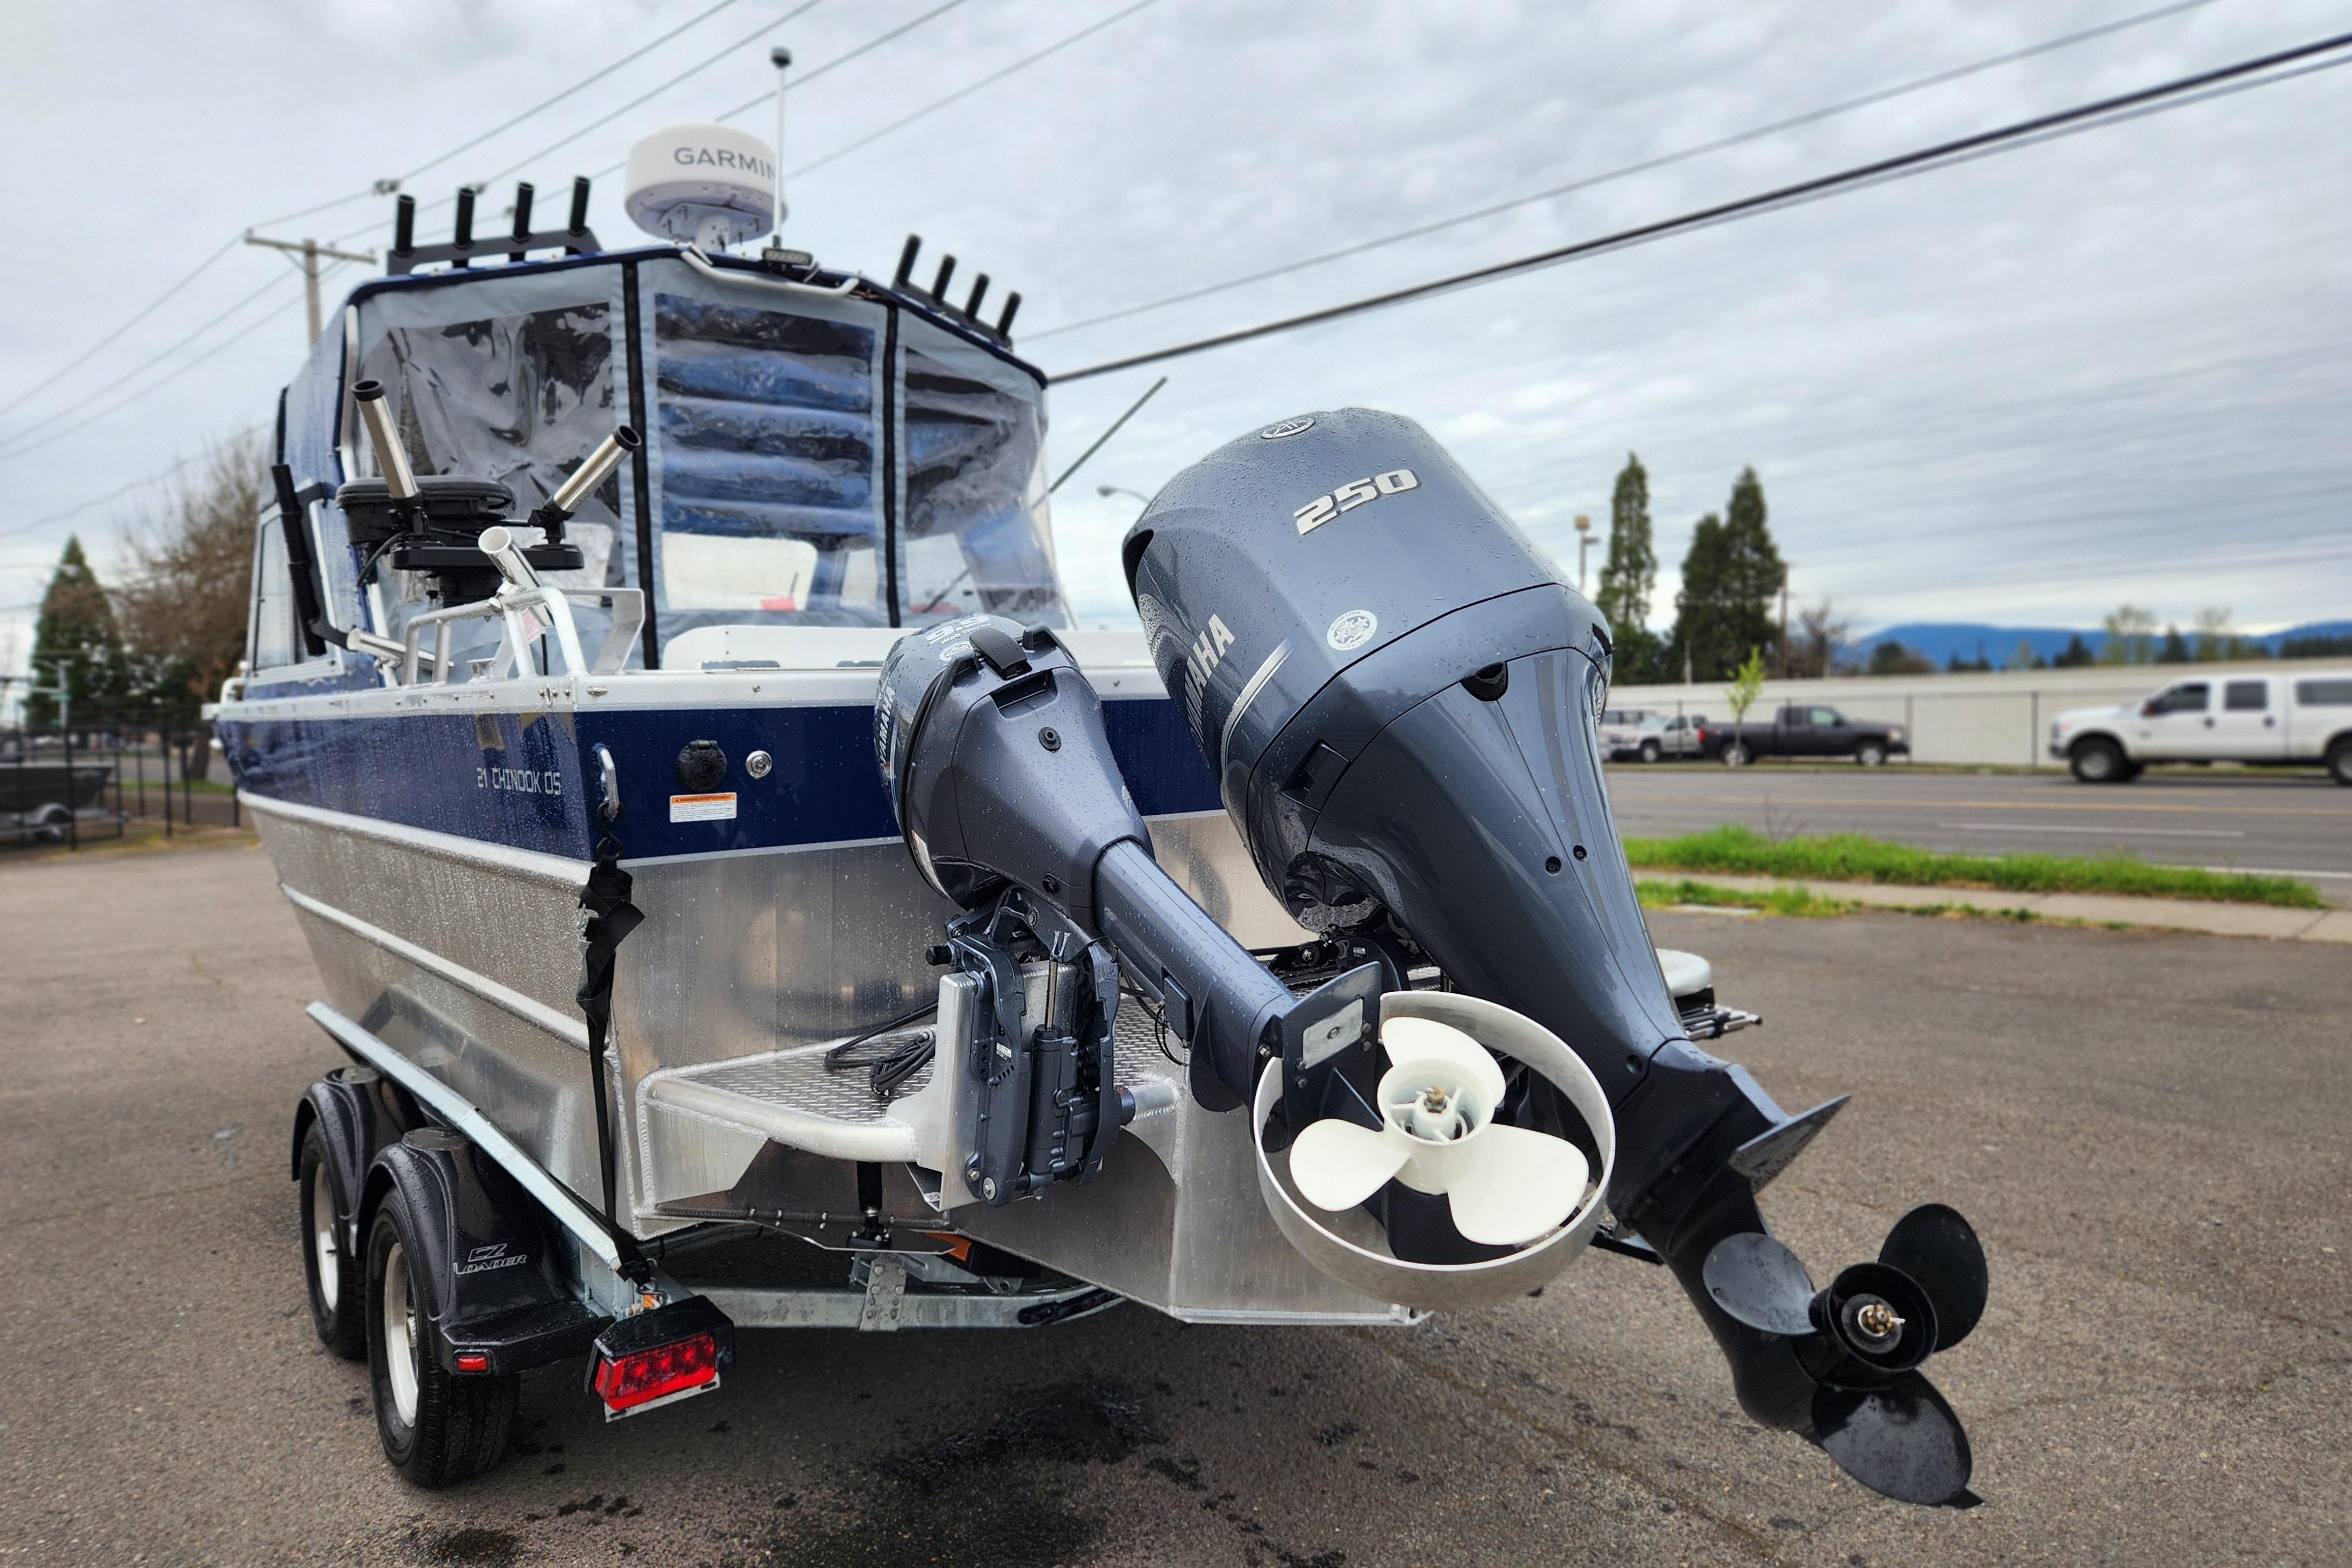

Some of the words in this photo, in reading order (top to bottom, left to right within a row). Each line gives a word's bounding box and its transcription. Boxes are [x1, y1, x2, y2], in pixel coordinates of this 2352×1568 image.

[674, 148, 776, 179] GARMIN
[1294, 469, 1418, 536] 250
[926, 615, 990, 644] 9.9
[880, 686, 896, 765] YAMAHA
[477, 767, 488, 788] 21
[491, 767, 542, 794] CHINOOK
[453, 1255, 527, 1275] LOADER
